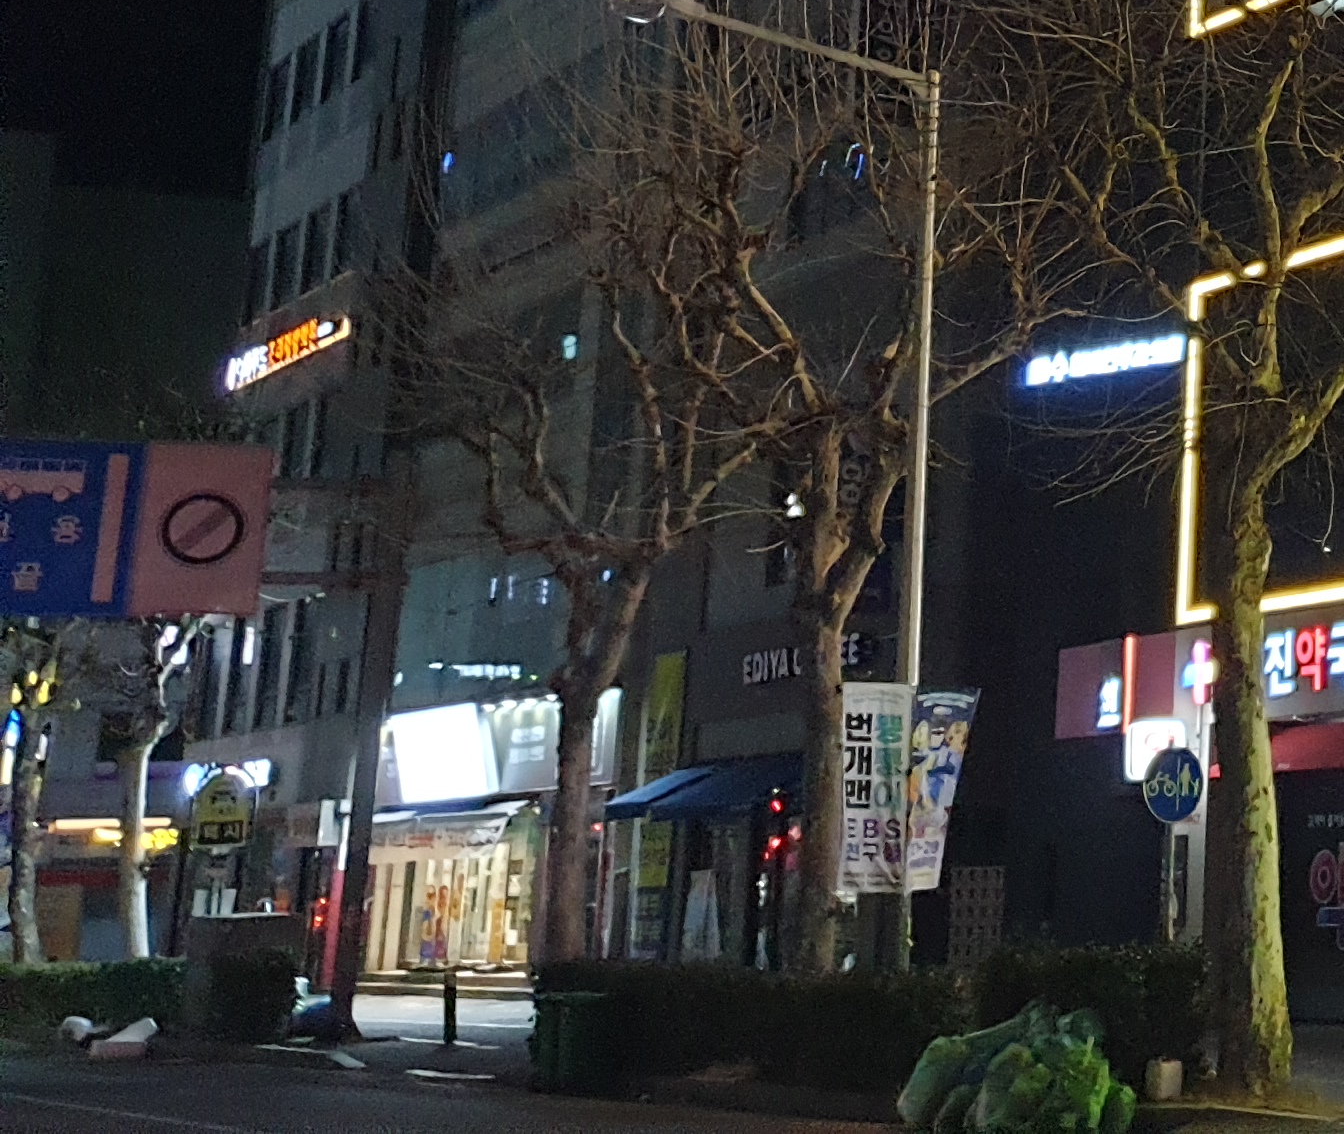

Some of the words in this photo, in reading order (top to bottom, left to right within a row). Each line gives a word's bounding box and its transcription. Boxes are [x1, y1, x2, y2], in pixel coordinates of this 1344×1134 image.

[742, 648, 790, 685] EDIYA
[844, 713, 873, 809] 번개맨
[847, 818, 901, 840] EBS
